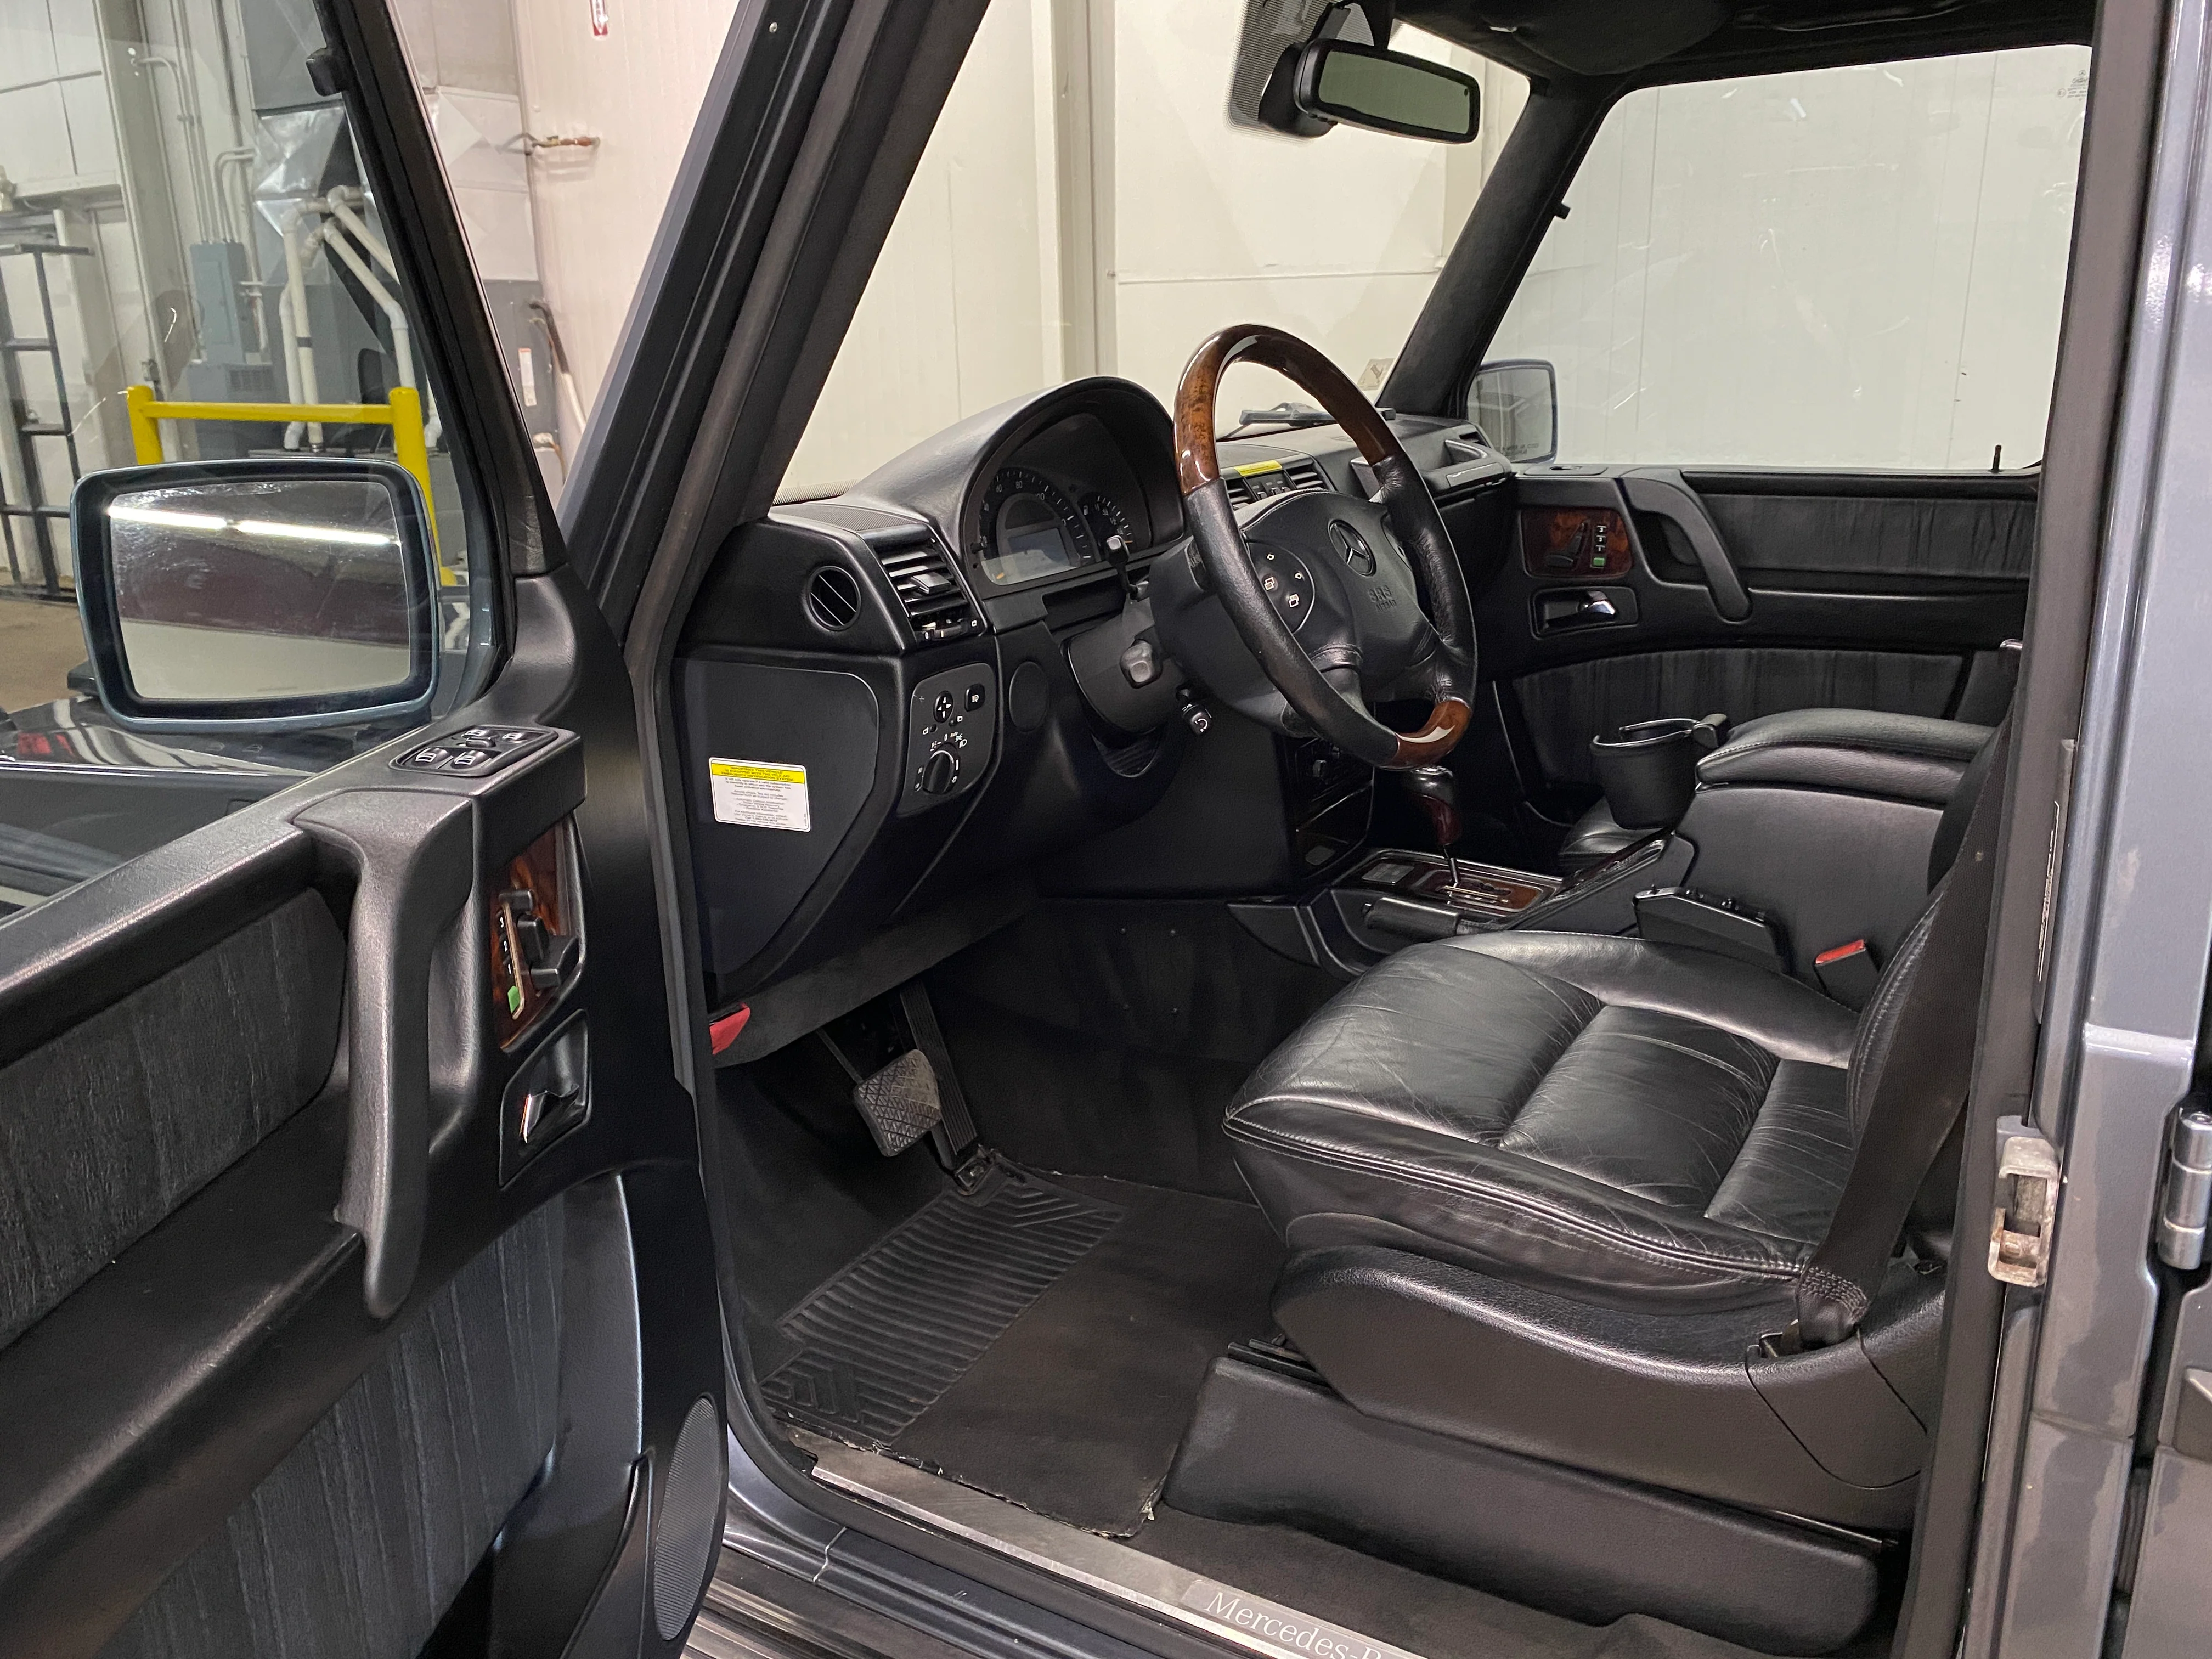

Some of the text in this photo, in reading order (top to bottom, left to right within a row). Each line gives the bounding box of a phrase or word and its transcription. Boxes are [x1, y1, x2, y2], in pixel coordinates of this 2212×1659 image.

[1015, 481, 1023, 489] 80
[500, 917, 504, 928] 3
[503, 940, 508, 952] 2
[508, 963, 512, 975] 1
